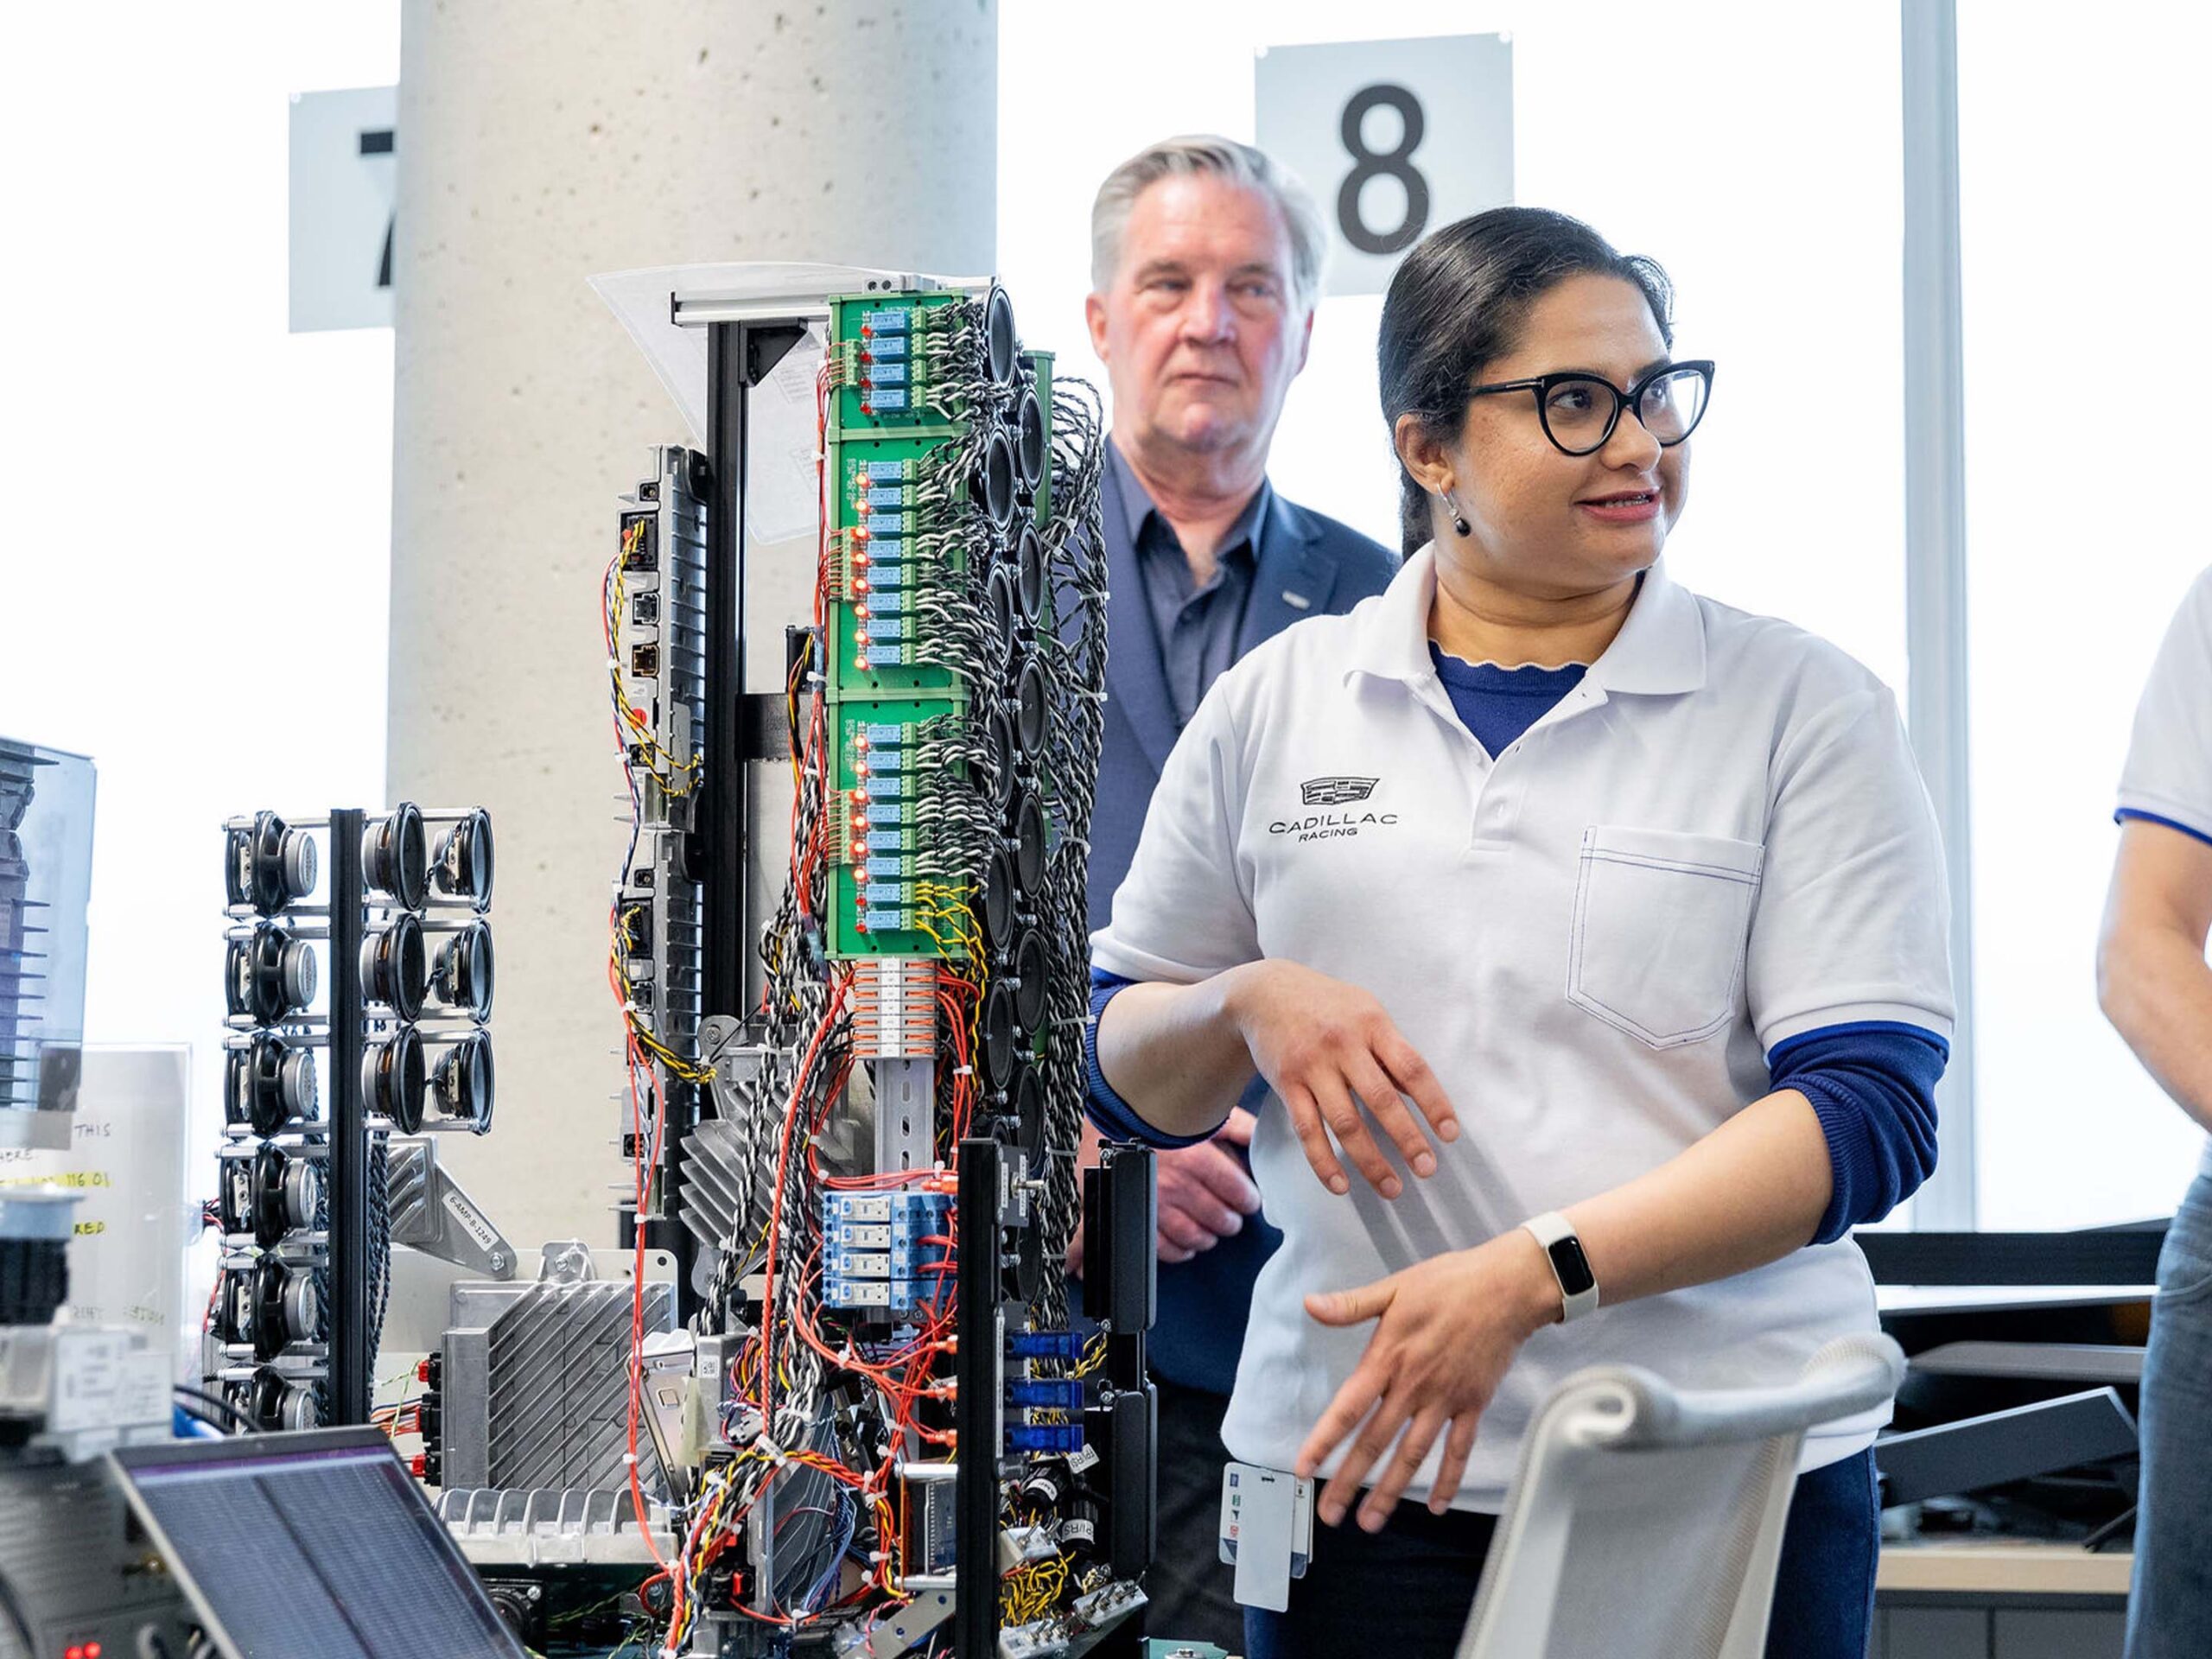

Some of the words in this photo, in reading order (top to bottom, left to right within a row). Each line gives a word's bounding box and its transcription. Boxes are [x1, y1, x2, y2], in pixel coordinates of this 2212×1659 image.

[1338, 85, 1428, 254] 8
[1269, 813, 1398, 834] CADILLAC
[1299, 828, 1357, 842] RACING
[74, 1124, 111, 1137] THIS
[449, 1197, 492, 1243] 6-AMP-B-1249
